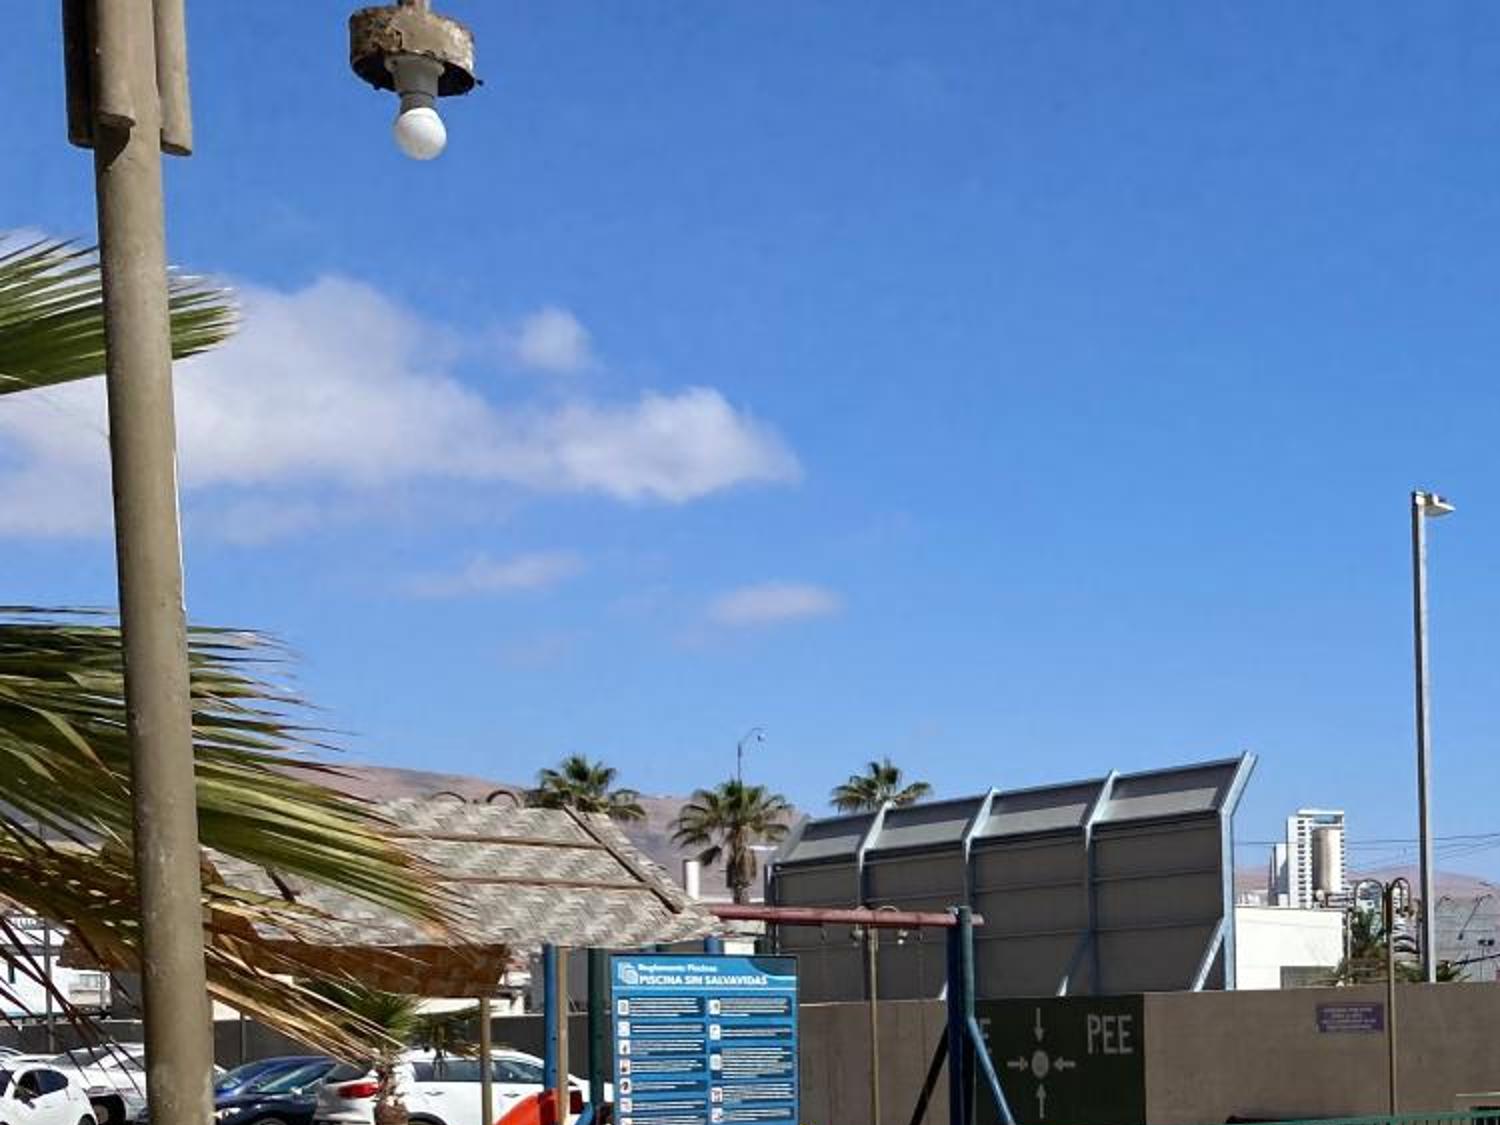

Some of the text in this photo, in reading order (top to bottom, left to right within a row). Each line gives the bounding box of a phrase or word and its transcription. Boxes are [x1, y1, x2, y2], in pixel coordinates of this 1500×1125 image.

[639, 975, 768, 985] PISCINA SIN SALVAVIDAS
[1087, 1013, 1134, 1055] PEE
